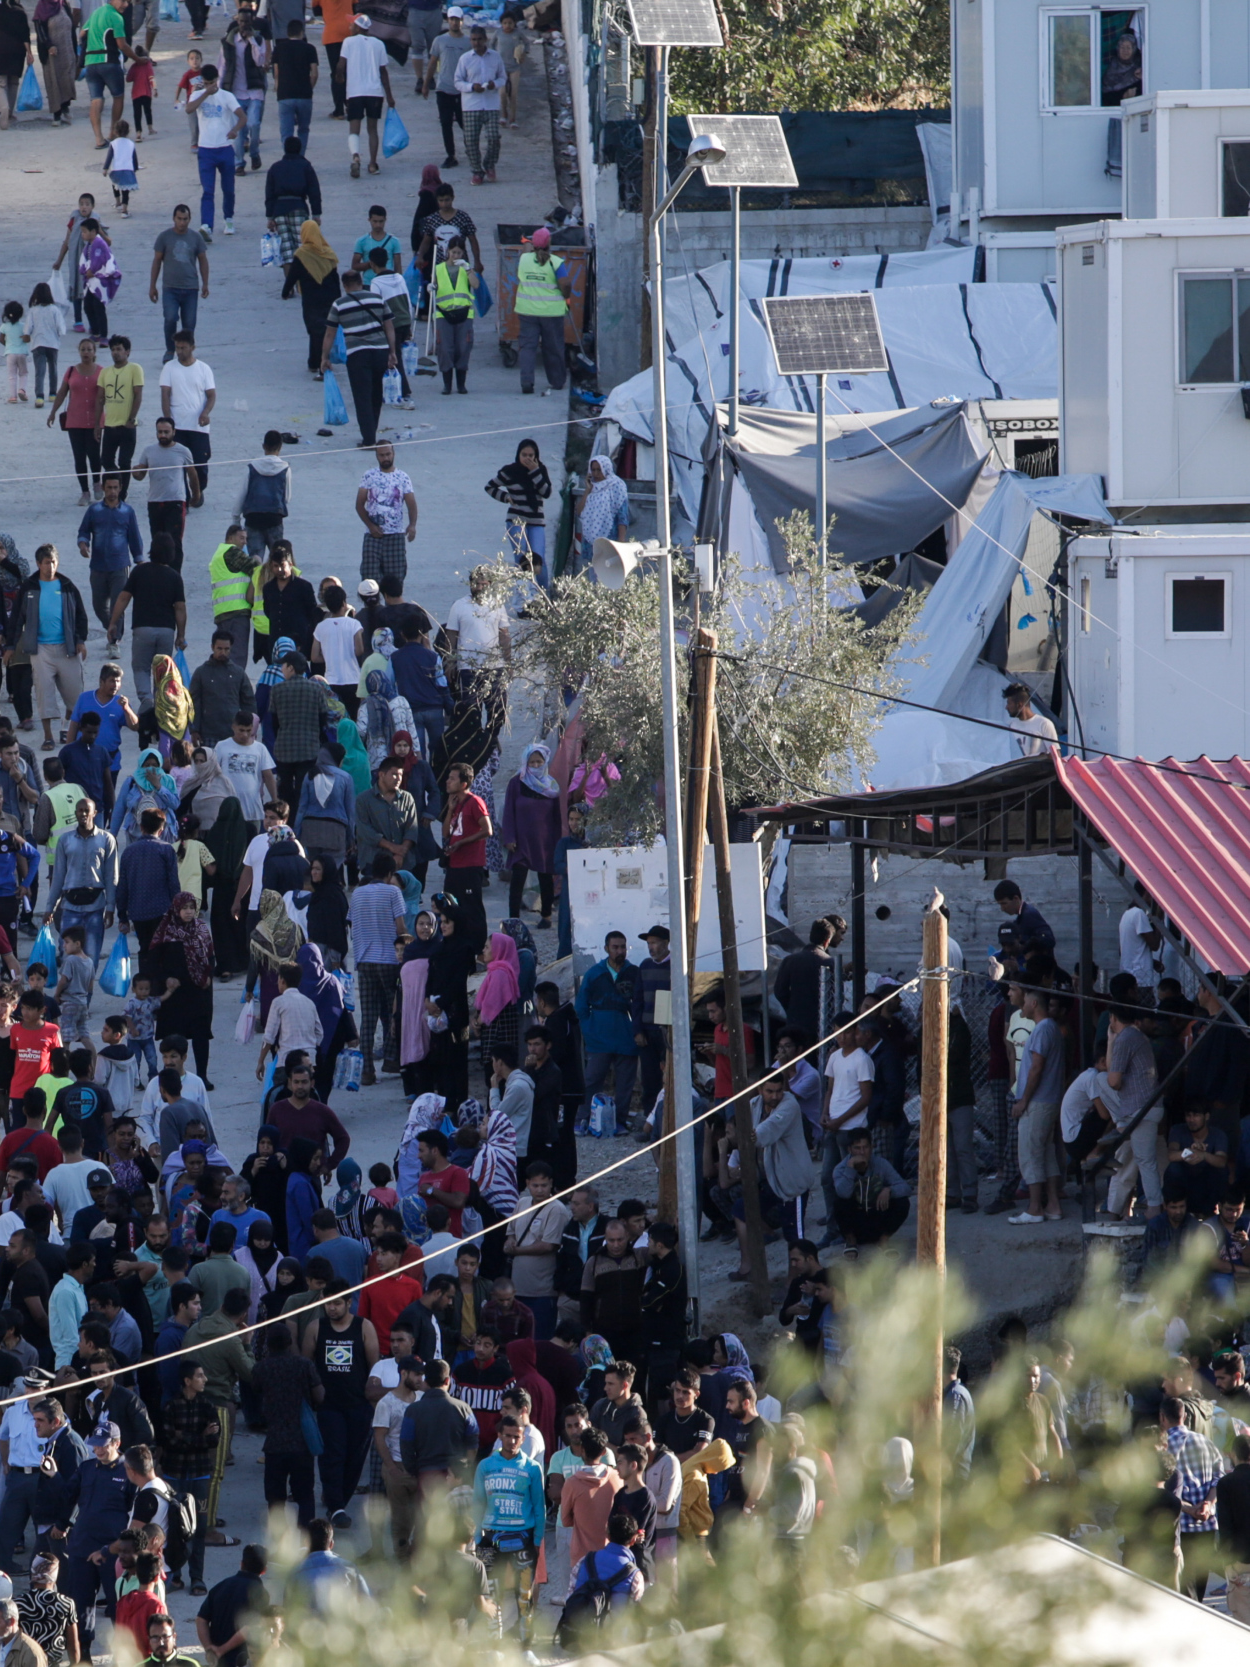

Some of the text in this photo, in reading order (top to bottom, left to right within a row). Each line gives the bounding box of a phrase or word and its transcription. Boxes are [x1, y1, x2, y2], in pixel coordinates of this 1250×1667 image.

[484, 1478, 516, 1490] BRONX
[495, 1498, 523, 1508] STREET
[499, 1506, 523, 1515] STYLE
